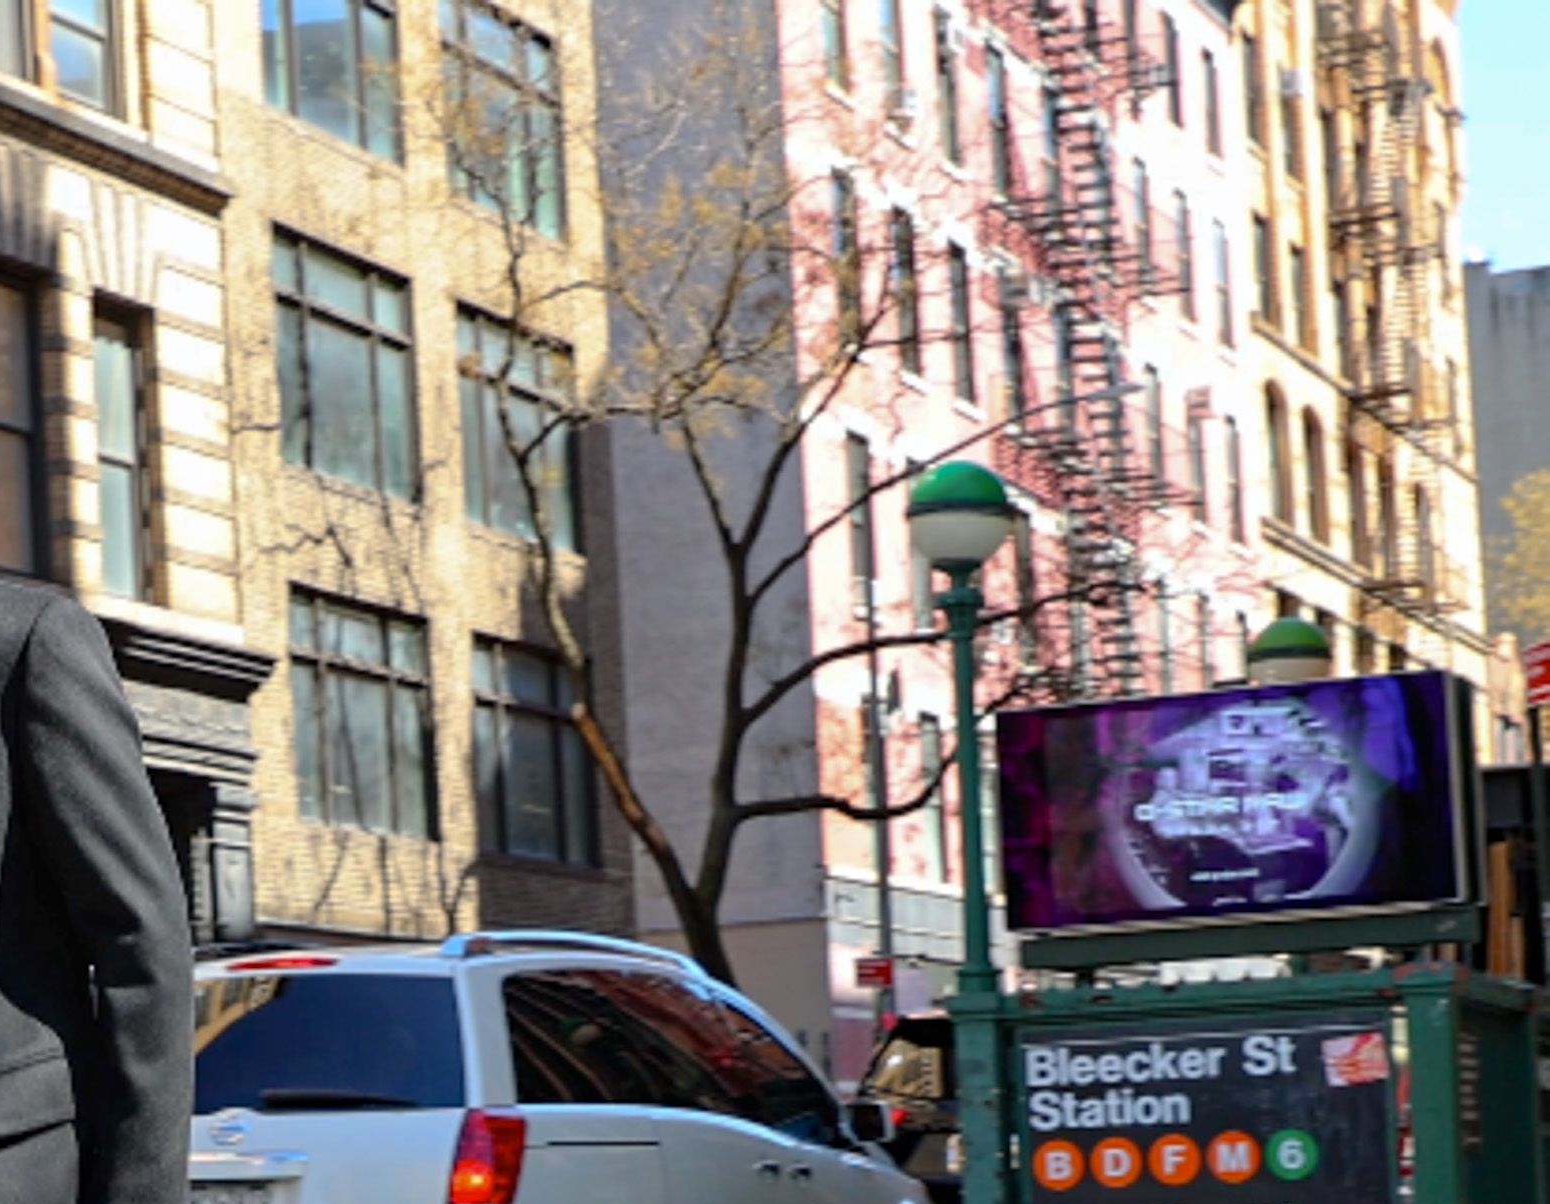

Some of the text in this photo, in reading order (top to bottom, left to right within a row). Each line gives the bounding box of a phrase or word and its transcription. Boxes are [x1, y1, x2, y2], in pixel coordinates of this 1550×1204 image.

[1026, 1042, 1226, 1087] Bleecker
[1242, 1035, 1296, 1075] St
[1029, 1088, 1191, 1130] Station
[1044, 1139, 1307, 1180] B D F M 6
